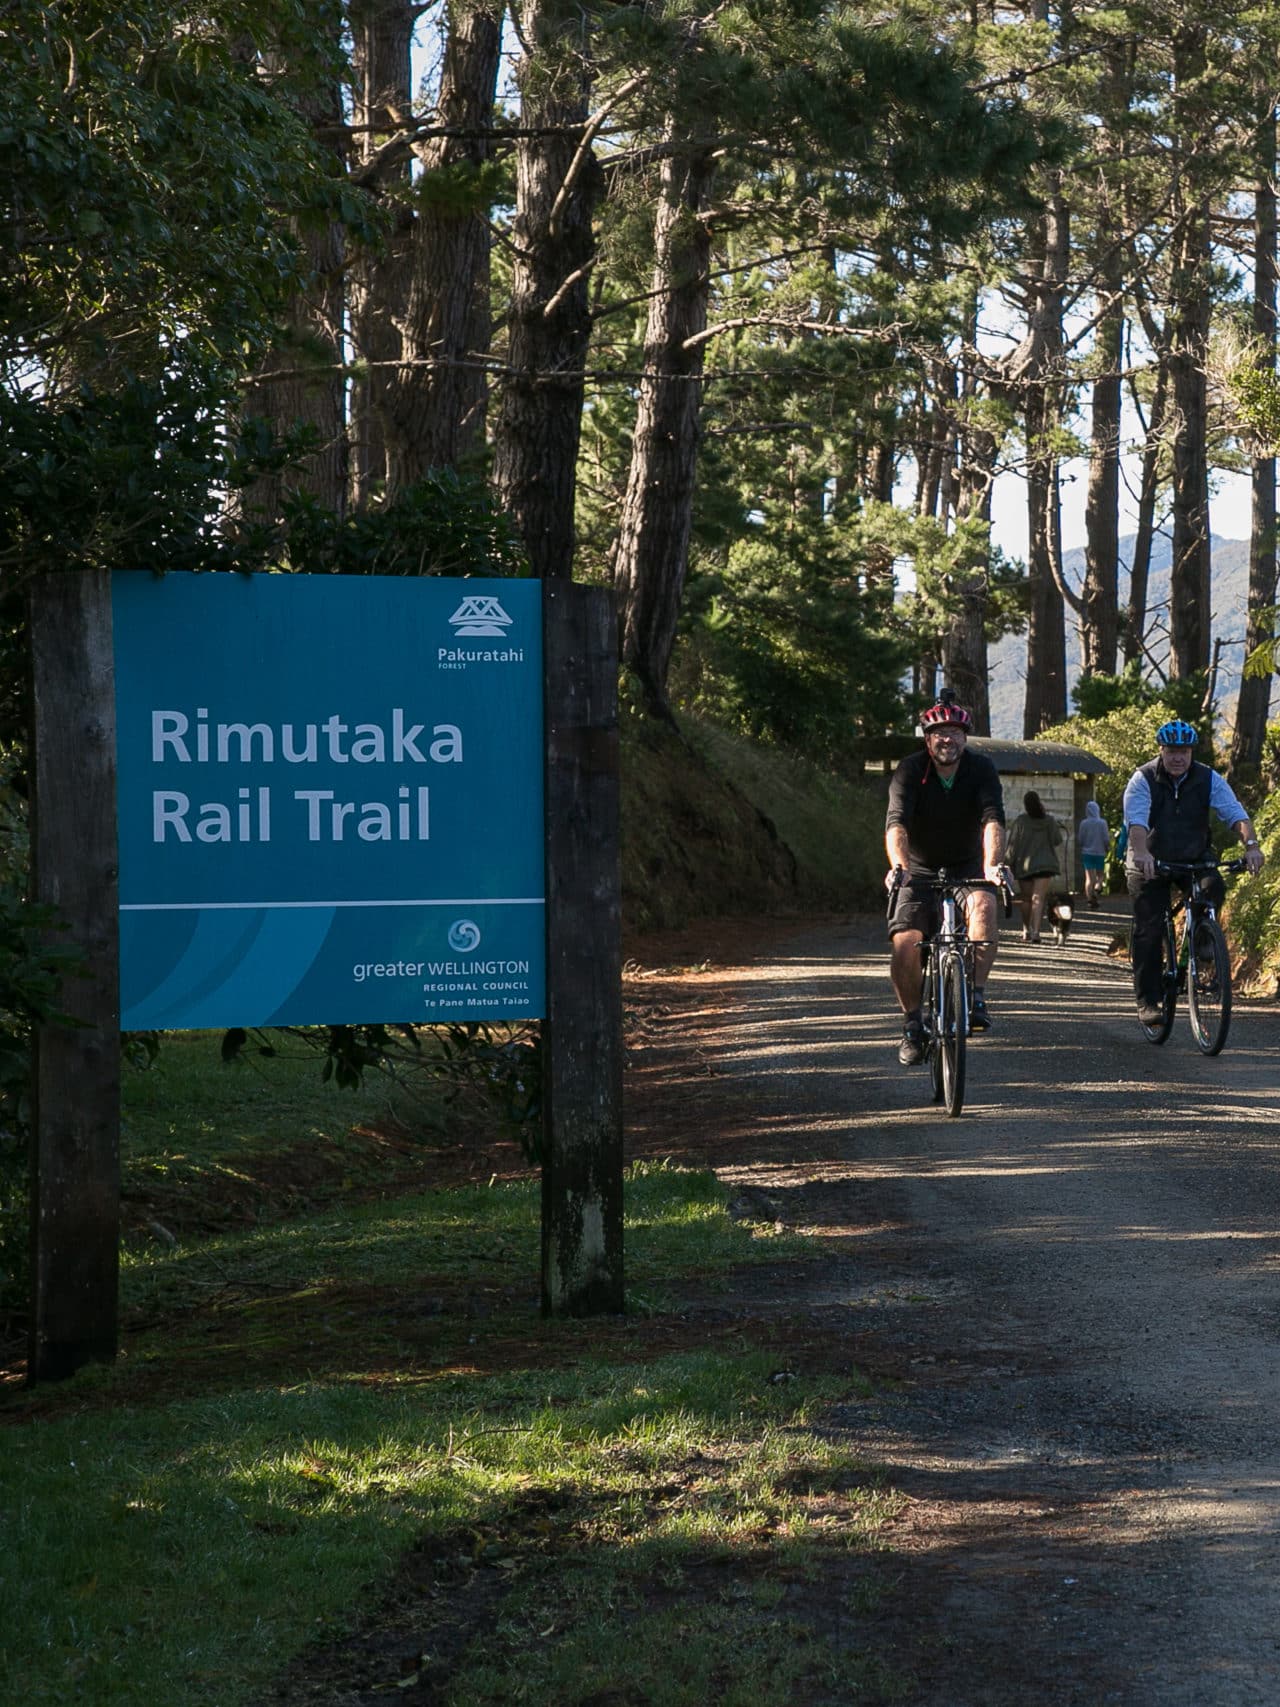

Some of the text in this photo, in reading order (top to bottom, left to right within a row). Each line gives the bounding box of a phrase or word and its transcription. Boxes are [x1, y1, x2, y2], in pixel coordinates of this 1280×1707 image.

[437, 647, 524, 662] Pakuratahi
[438, 662, 467, 670] FOREST
[151, 707, 464, 763] Rimutaka
[152, 785, 430, 843] Rail Trail
[353, 961, 529, 982] greater WELLINGTON
[423, 981, 529, 992] REGIONAL COUNCIL
[424, 996, 530, 1008] Te Pane Matua Taiao
